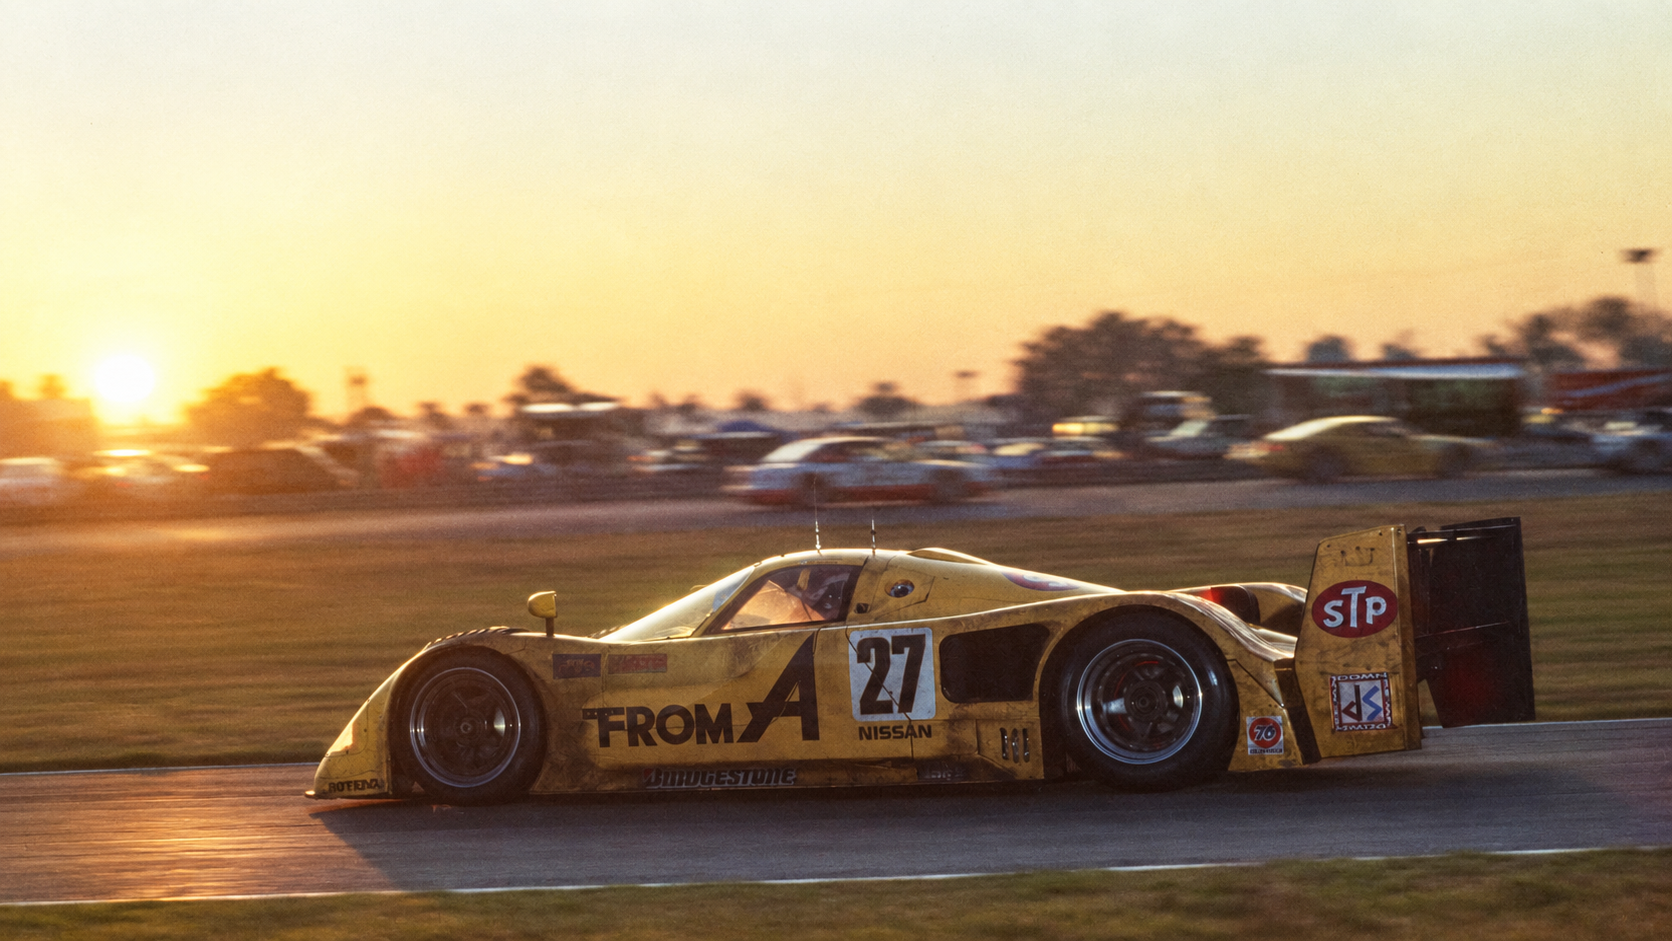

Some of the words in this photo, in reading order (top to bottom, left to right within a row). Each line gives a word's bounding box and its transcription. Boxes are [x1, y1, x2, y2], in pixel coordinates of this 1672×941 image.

[1323, 585, 1387, 628] STP
[582, 704, 734, 748] FROM
[736, 632, 820, 743] A
[857, 634, 926, 715] 27
[858, 724, 932, 740] NISSAN
[1254, 724, 1276, 741] 76
